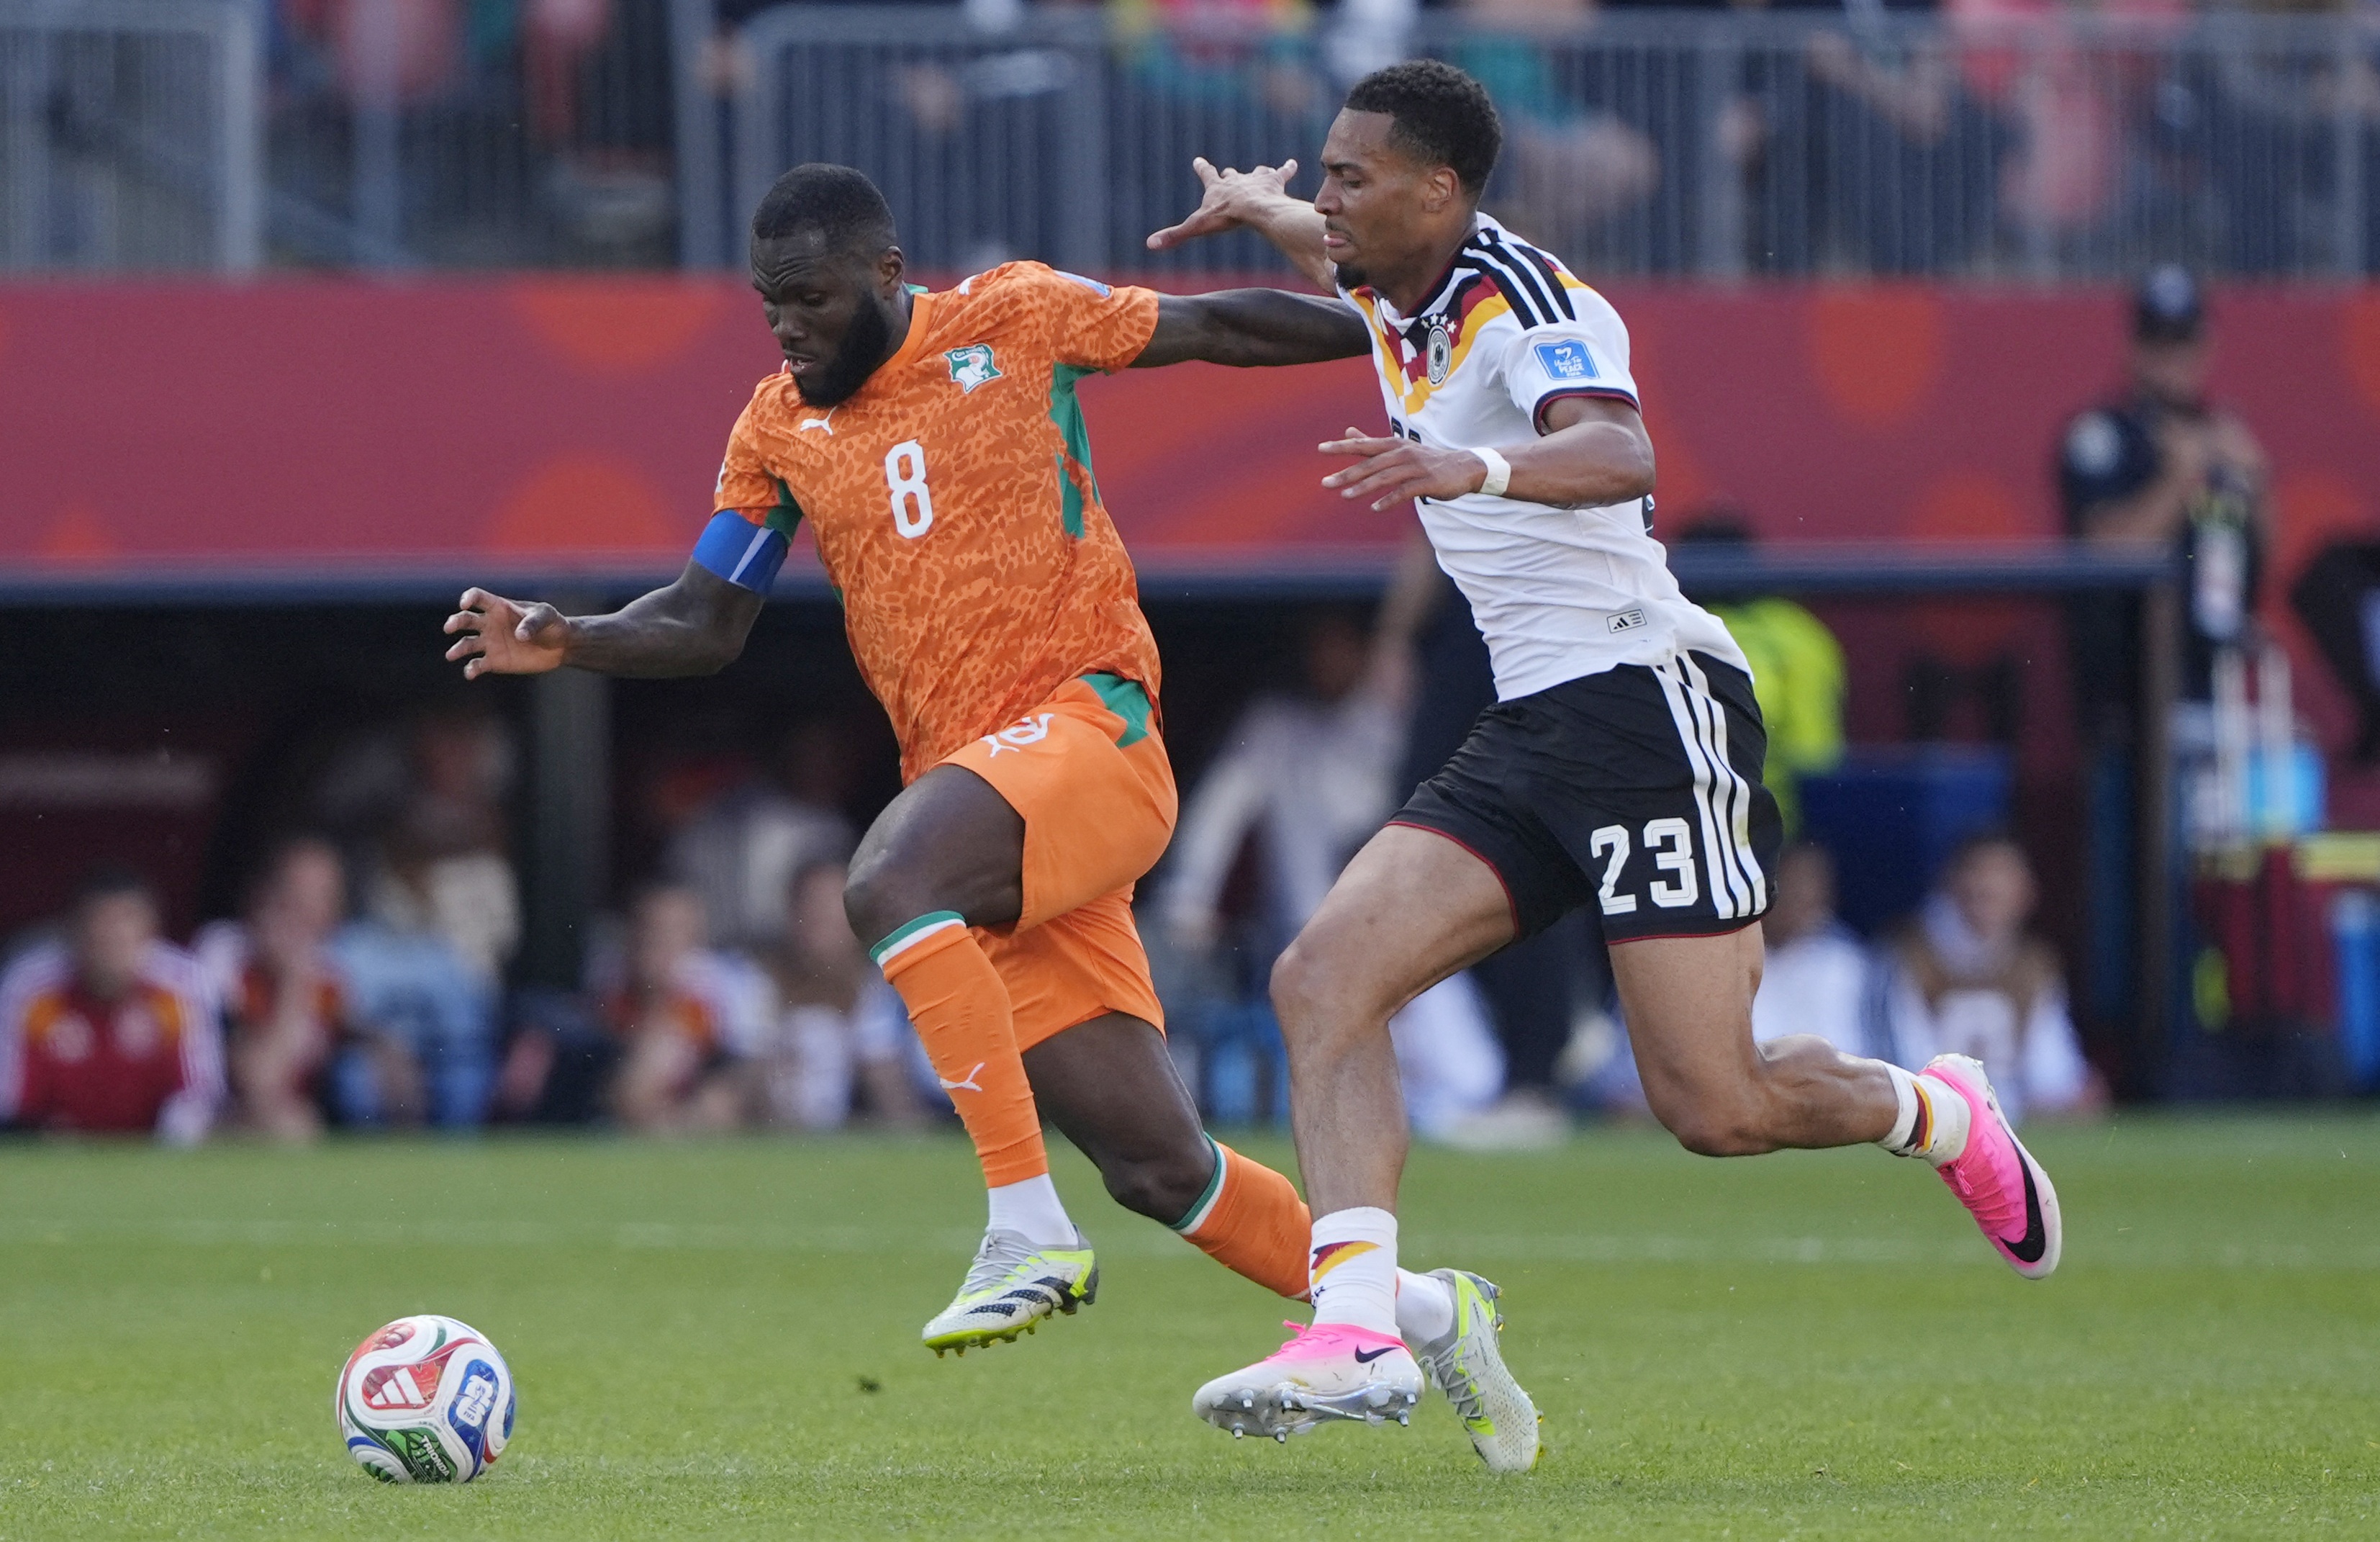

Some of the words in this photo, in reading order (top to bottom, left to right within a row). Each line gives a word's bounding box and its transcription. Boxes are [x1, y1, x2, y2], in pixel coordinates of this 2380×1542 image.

[884, 439, 933, 539] 8
[1590, 817, 1698, 915] 23
[421, 1435, 450, 1476] TRIONDA
